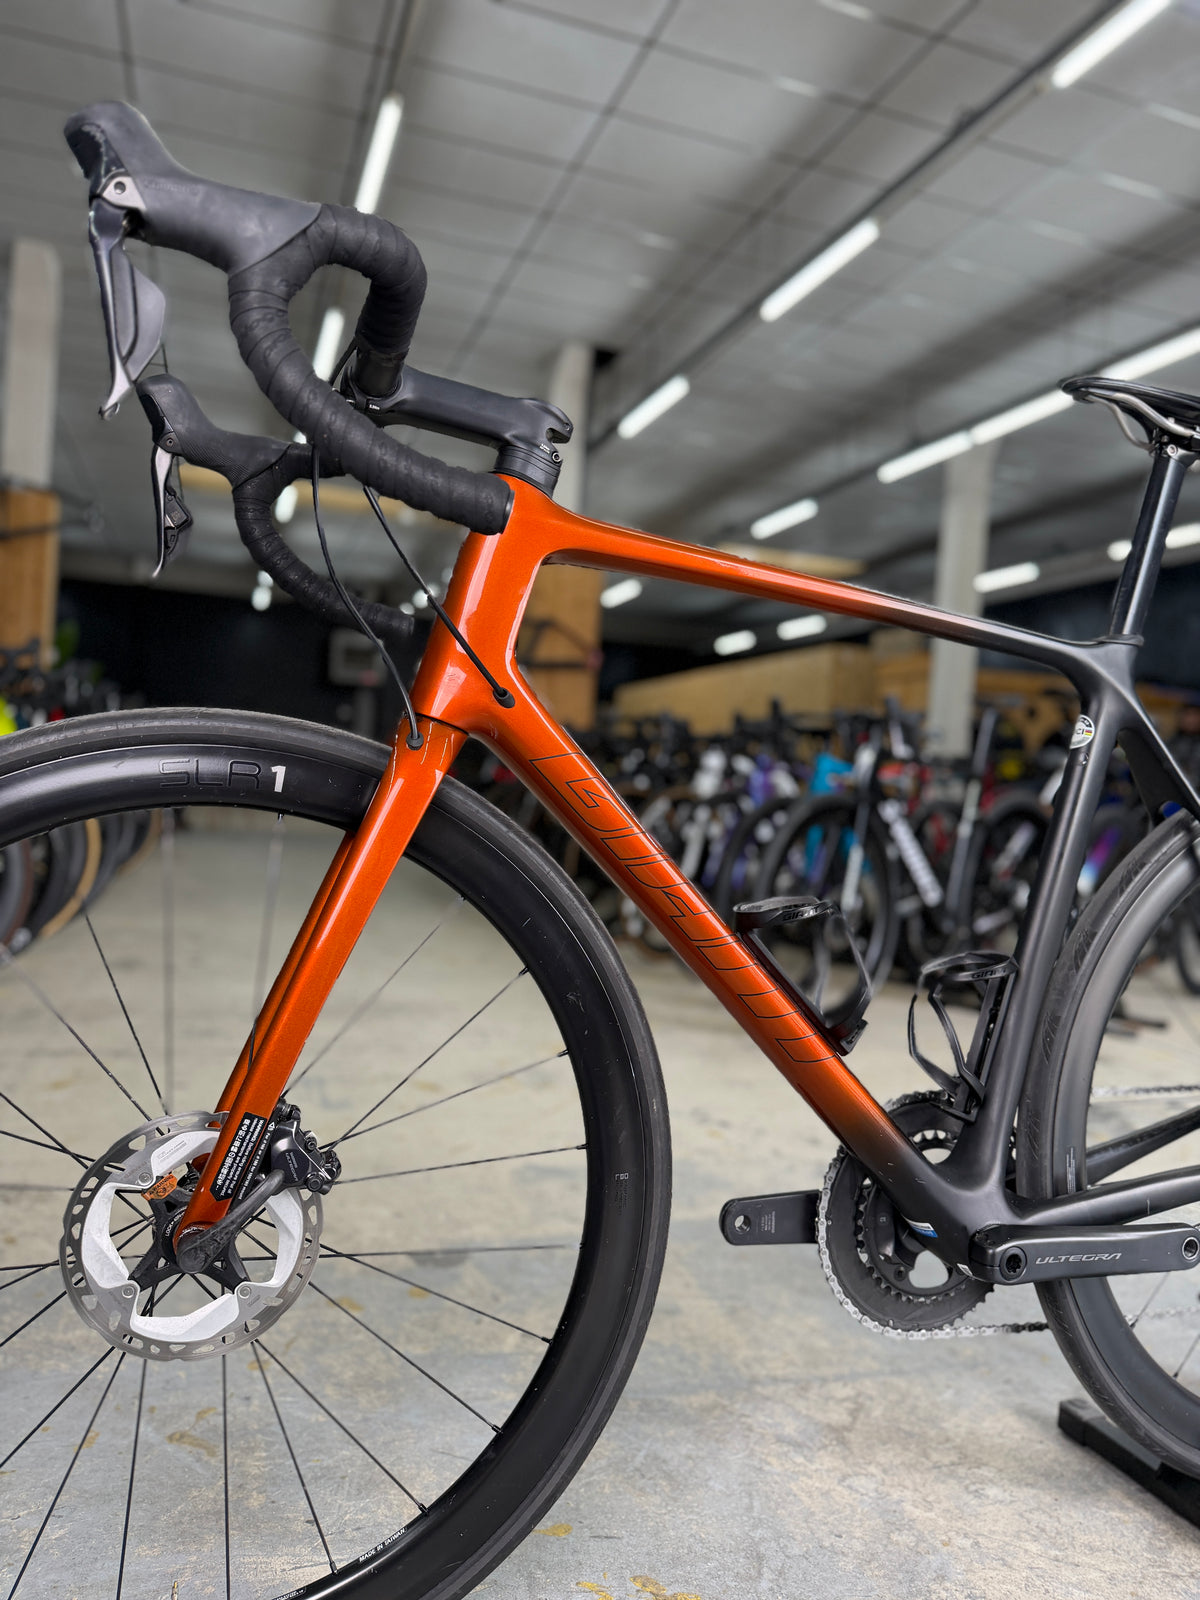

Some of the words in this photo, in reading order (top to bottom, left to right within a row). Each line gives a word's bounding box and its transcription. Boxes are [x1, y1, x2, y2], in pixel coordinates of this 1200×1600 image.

[160, 758, 262, 790] SLR
[270, 765, 287, 793] 1
[1035, 1252, 1122, 1265] ULTEGRA
[359, 1550, 376, 1562] MADE
